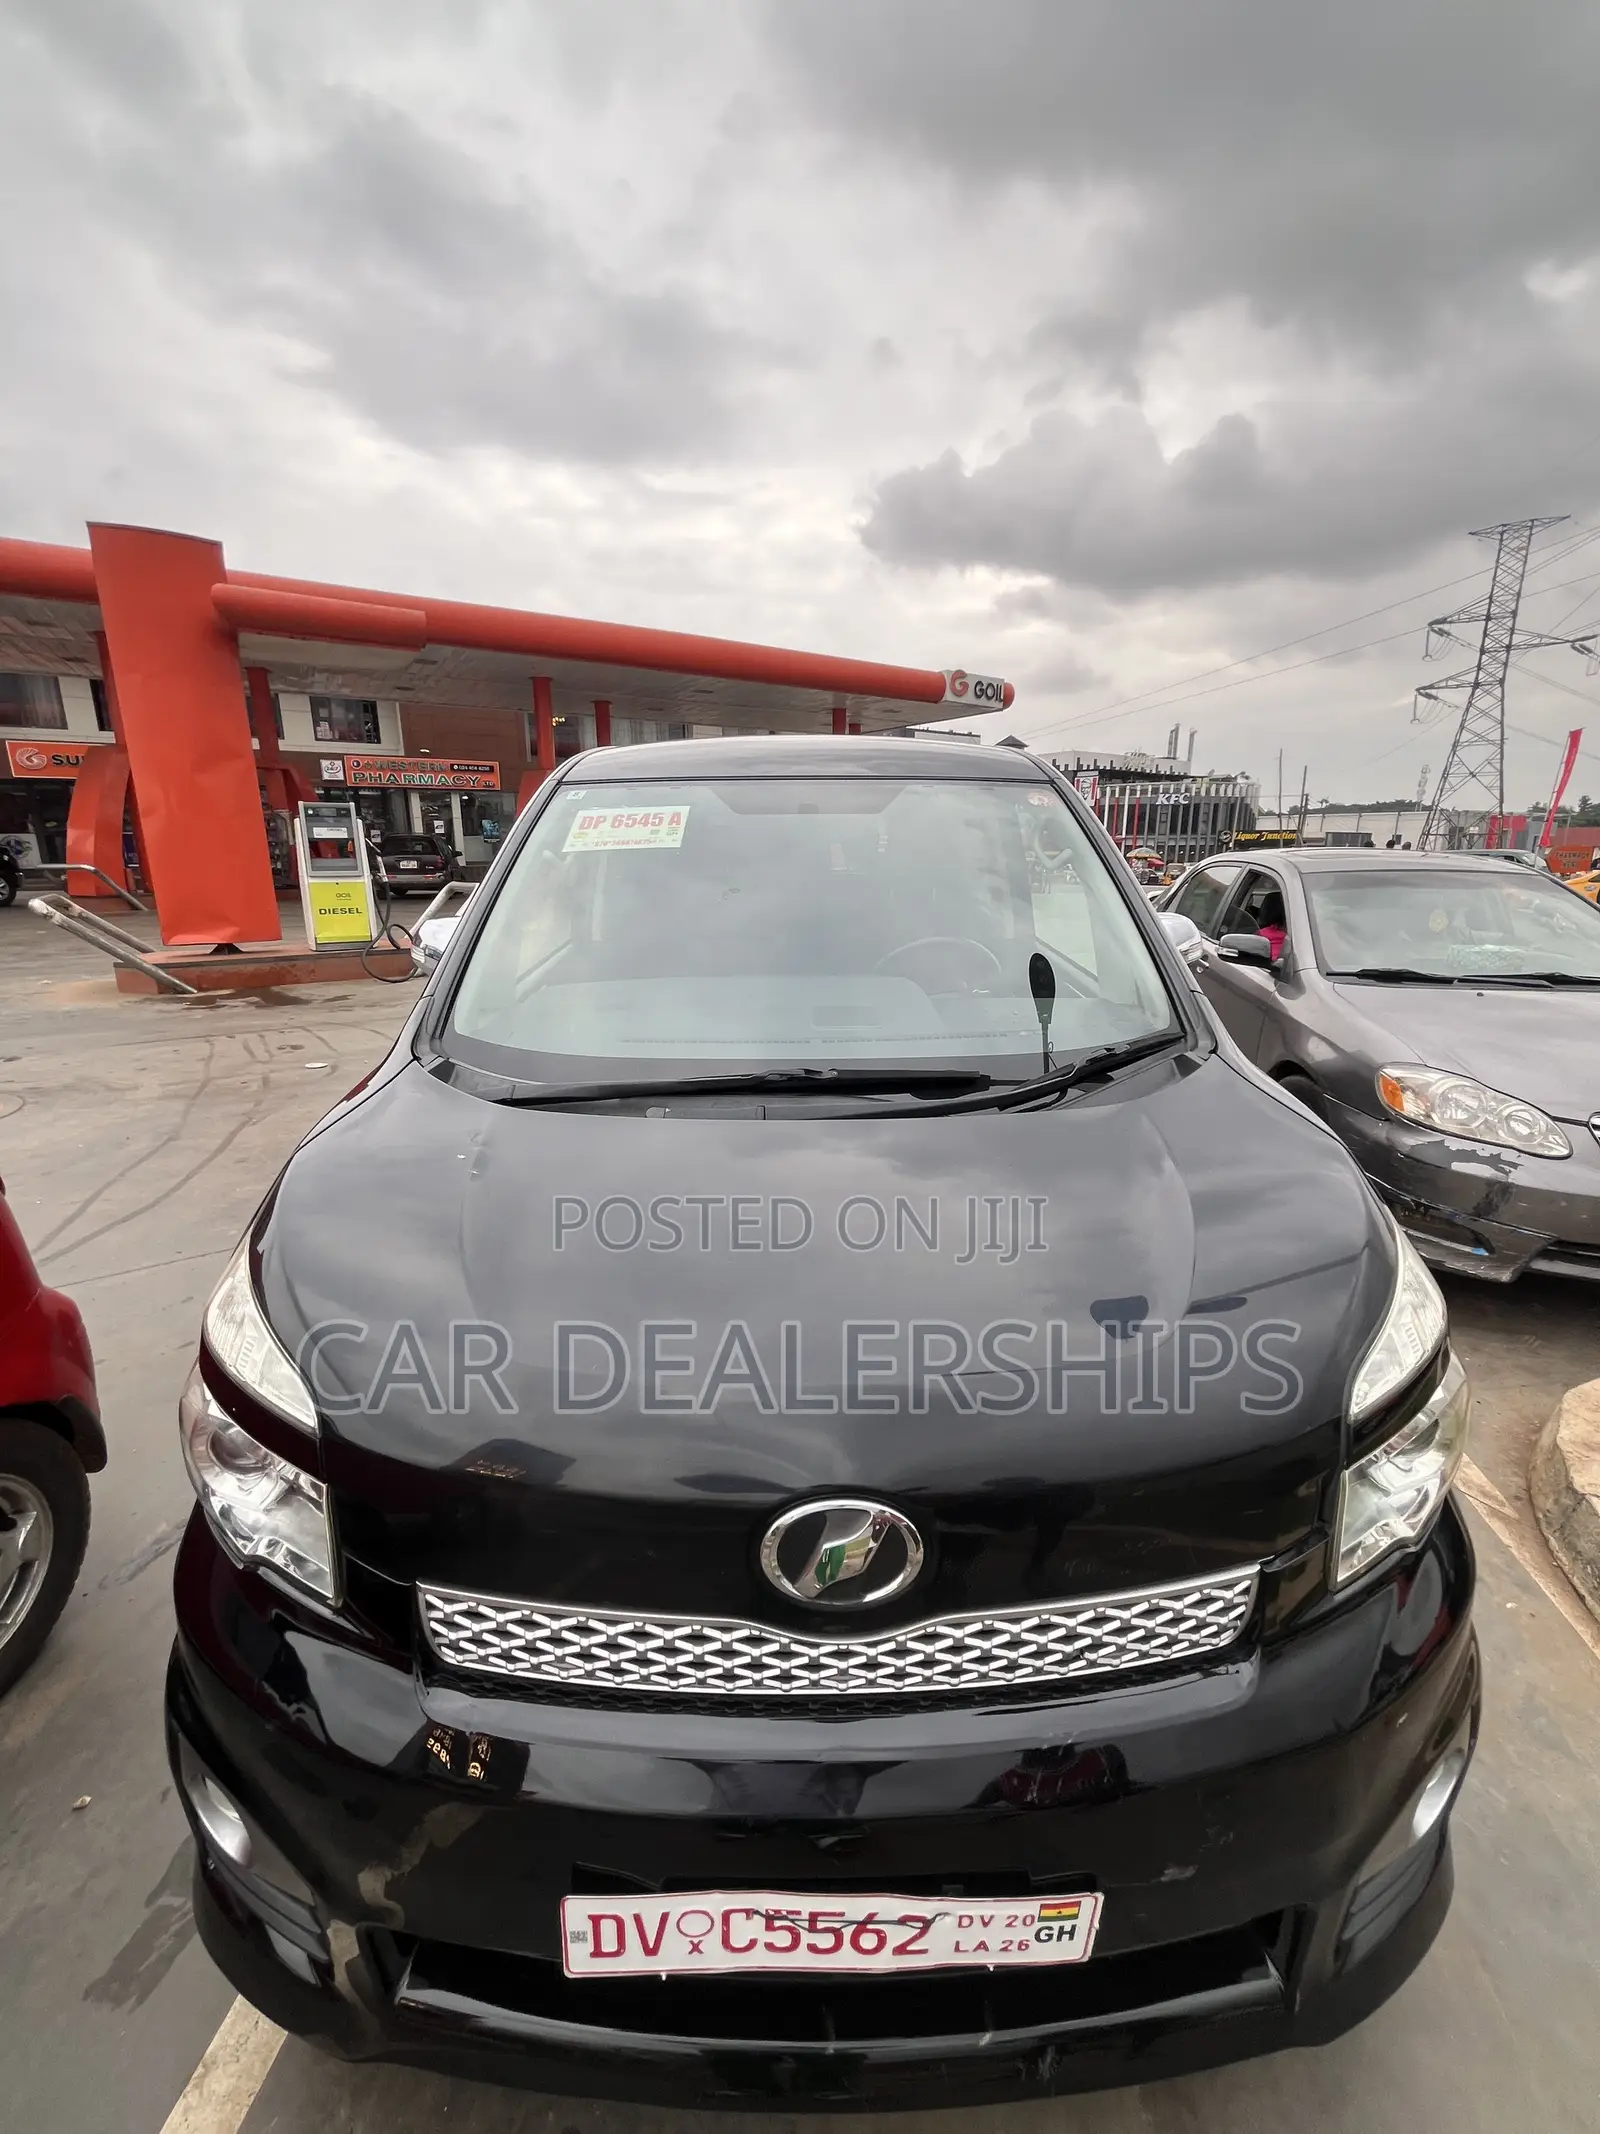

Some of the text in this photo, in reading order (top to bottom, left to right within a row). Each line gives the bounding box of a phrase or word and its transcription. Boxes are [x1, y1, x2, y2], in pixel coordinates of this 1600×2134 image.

[974, 680, 1004, 702] GOIL
[51, 754, 85, 766] SU
[351, 771, 481, 787] PHARMACY
[1155, 791, 1191, 806] KFC
[578, 811, 682, 831] DP 6545 A
[1233, 830, 1297, 841] Liquor Junction
[318, 907, 363, 915] DIESEL
[956, 1913, 1036, 1929] DV 20
[587, 1907, 930, 1959] DV C5562
[1033, 1923, 1078, 1944] GH
[953, 1938, 1031, 1953] LA 26
